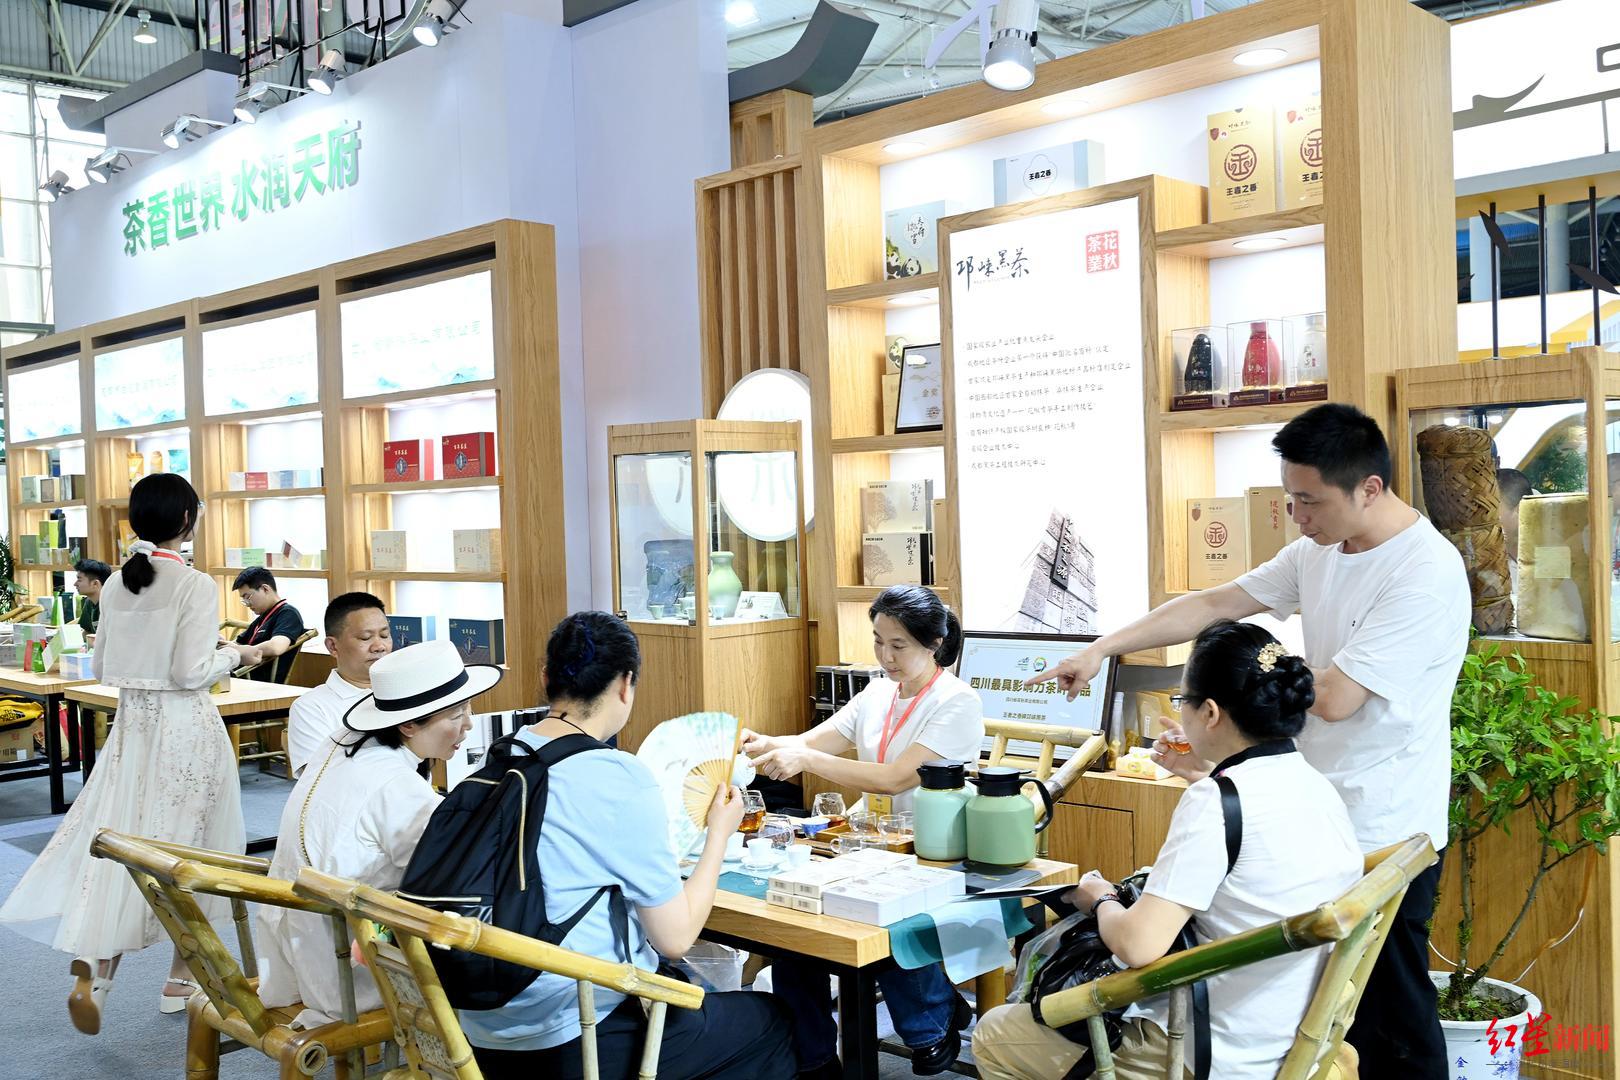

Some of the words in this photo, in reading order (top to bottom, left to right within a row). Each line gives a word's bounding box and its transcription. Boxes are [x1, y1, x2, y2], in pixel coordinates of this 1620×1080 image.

[123, 169, 224, 257] 茶香世界
[231, 119, 362, 222] 水润天府
[970, 676, 1091, 697] 四川最具影响力茶品
